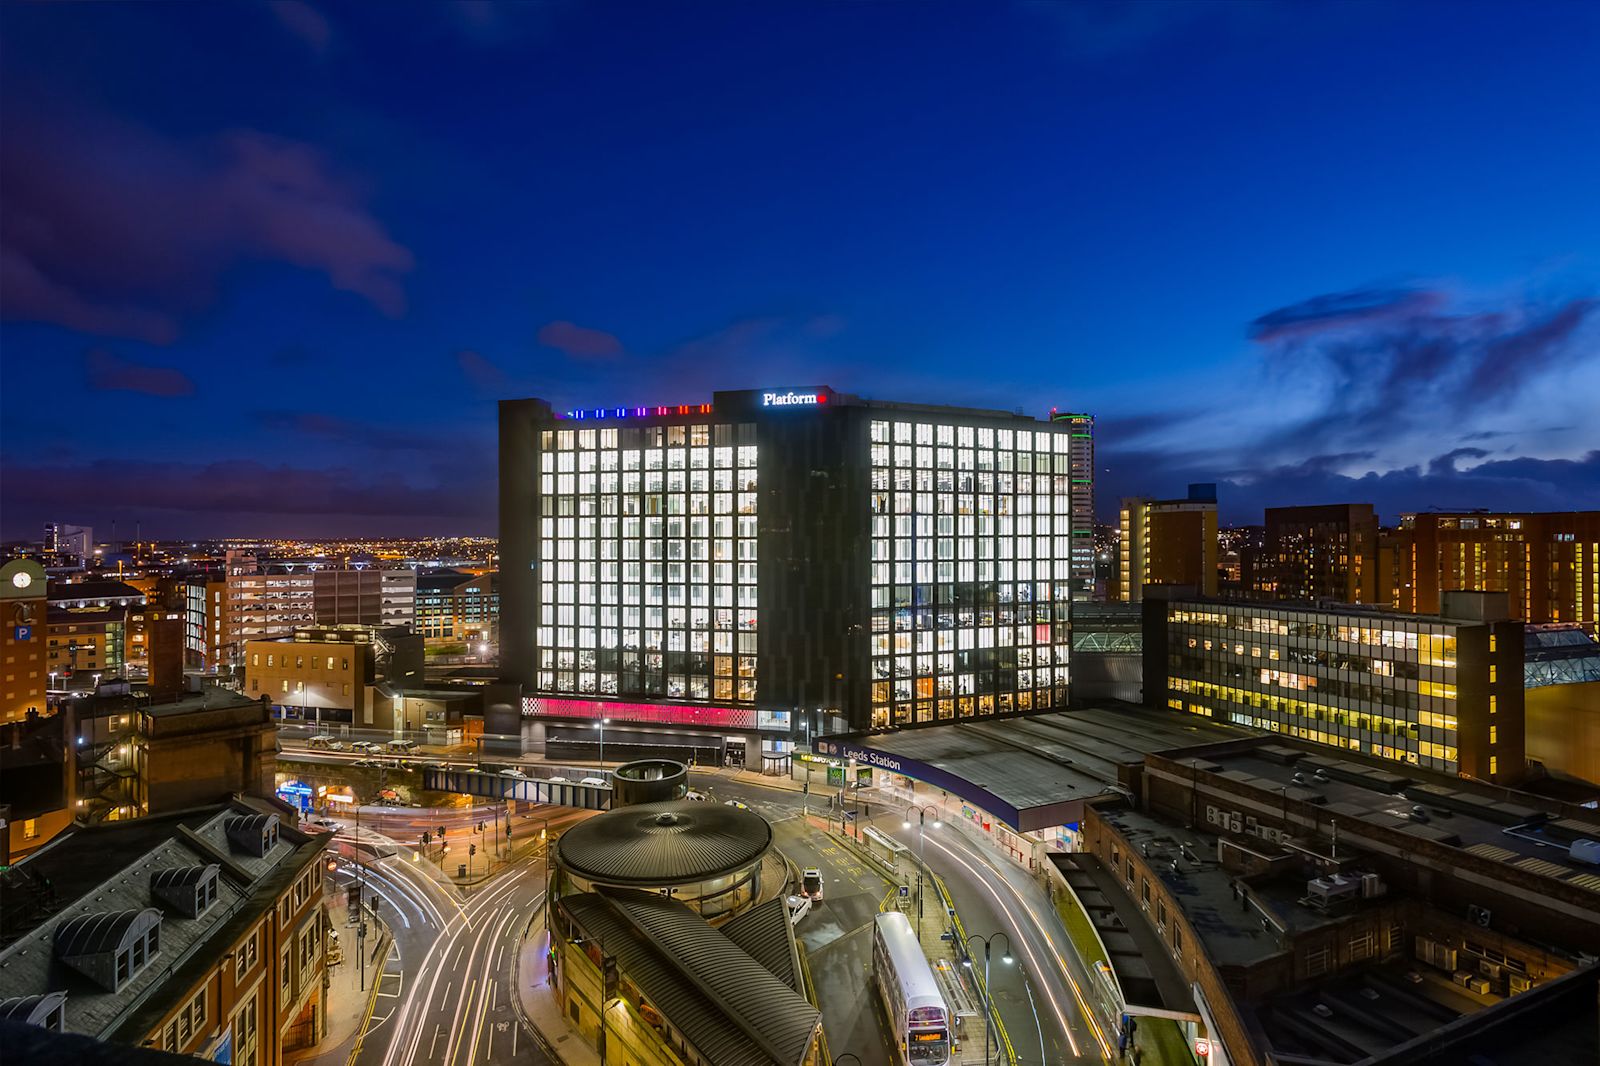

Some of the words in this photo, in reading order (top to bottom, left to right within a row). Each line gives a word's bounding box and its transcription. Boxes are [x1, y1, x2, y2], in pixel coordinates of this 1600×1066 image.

[763, 392, 817, 406] Platform
[19, 628, 28, 639] P
[843, 747, 869, 761] Leeds
[869, 753, 901, 770] Station
